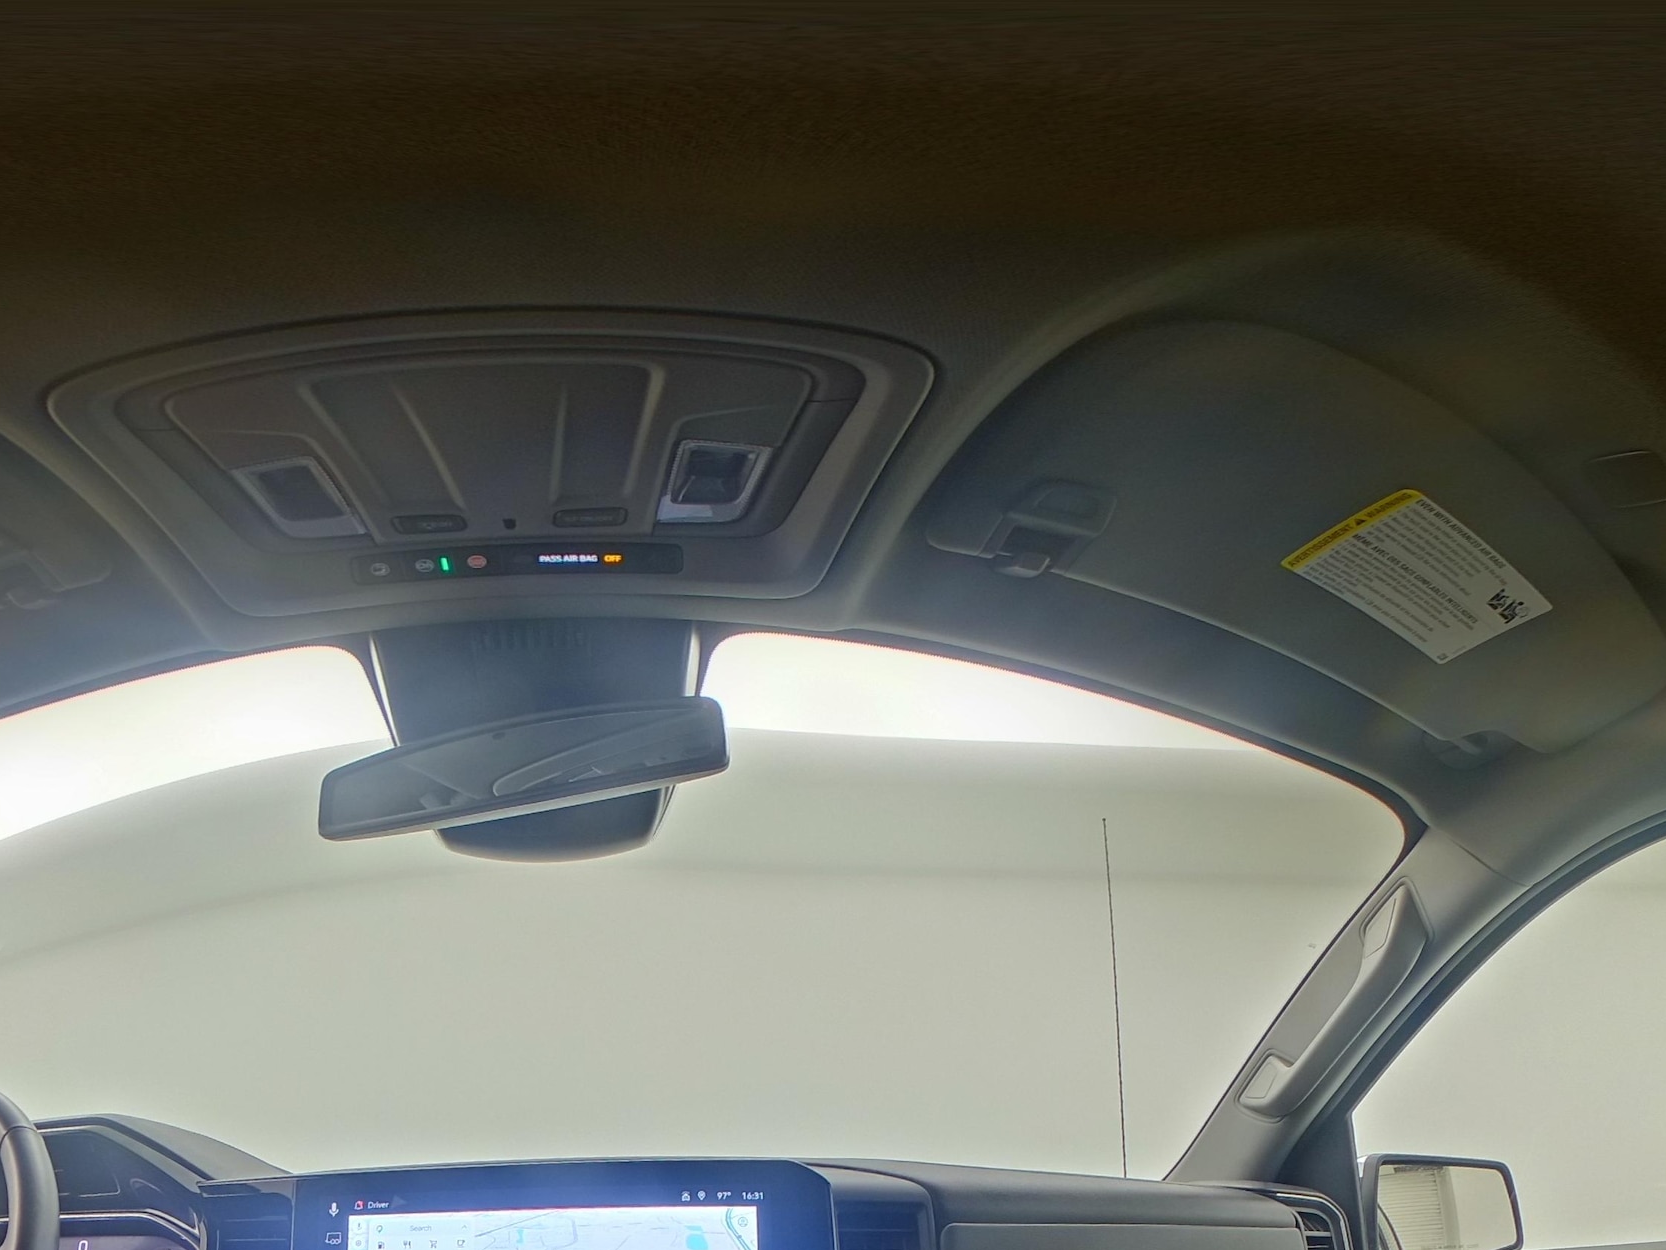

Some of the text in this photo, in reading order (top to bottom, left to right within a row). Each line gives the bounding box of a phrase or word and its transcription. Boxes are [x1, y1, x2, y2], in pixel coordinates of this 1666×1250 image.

[1365, 493, 1412, 518] WARNING
[1415, 499, 1435, 513] EVEN
[1433, 511, 1451, 525] WITH
[1370, 545, 1389, 558] AVEC
[538, 555, 562, 563] PASS
[716, 1191, 764, 1200] 97° 16:31
[368, 1201, 389, 1209] Driver
